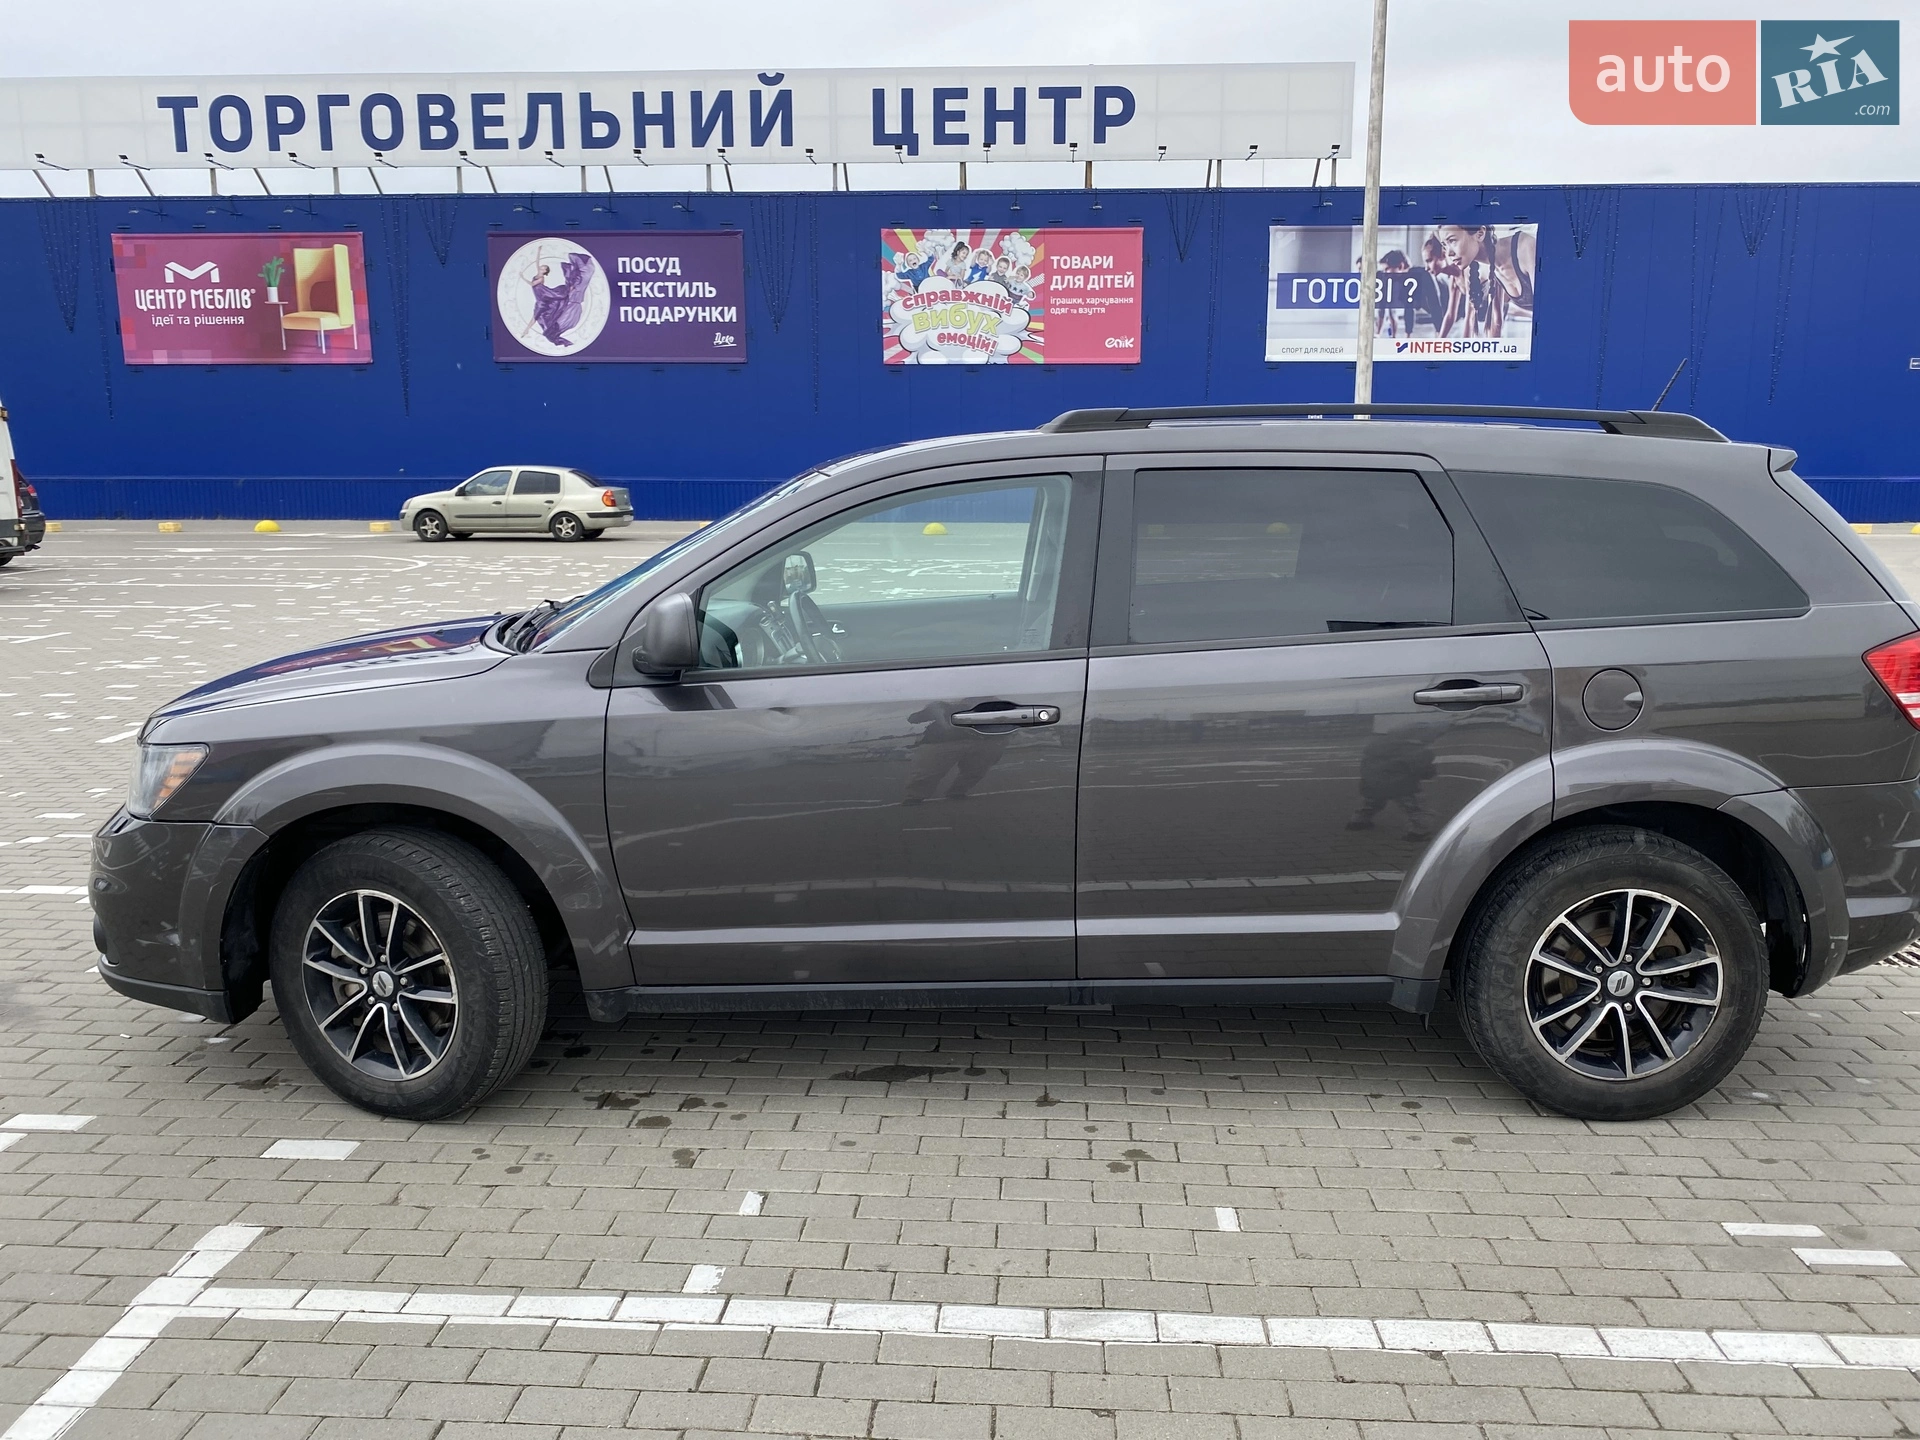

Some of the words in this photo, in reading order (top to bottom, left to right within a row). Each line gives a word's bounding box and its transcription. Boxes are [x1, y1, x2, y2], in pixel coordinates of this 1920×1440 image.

[157, 72, 794, 153] ТОРГОВЕЛЬНИЙ
[872, 84, 1136, 155] ЦЕНТР
[617, 256, 682, 276] ПОСУД
[1050, 255, 1114, 269] ТОВАРИ
[617, 281, 717, 298] ТЕКСТИЛЬ
[1050, 275, 1084, 291] ДЛЯ
[1087, 271, 1135, 291] ДІТЕЙ
[134, 288, 187, 312] ЦЕНТР
[902, 290, 1013, 315] справжній
[1050, 296, 1085, 306] іграшки,
[1086, 297, 1133, 306] харчування
[151, 313, 175, 327] ідеї
[177, 314, 191, 325] та
[194, 313, 245, 327] рішення
[619, 306, 737, 325] ПОДАРУНКИ
[912, 303, 1001, 336] вибух
[1050, 307, 1069, 315] одяг
[1078, 307, 1106, 316] взуття
[937, 333, 997, 354] емоцій!
[1303, 347, 1319, 355] ДЛЯ
[1319, 345, 1344, 355] ЛЮДЕЙ
[1410, 341, 1517, 354] INTERSPORT.ua
